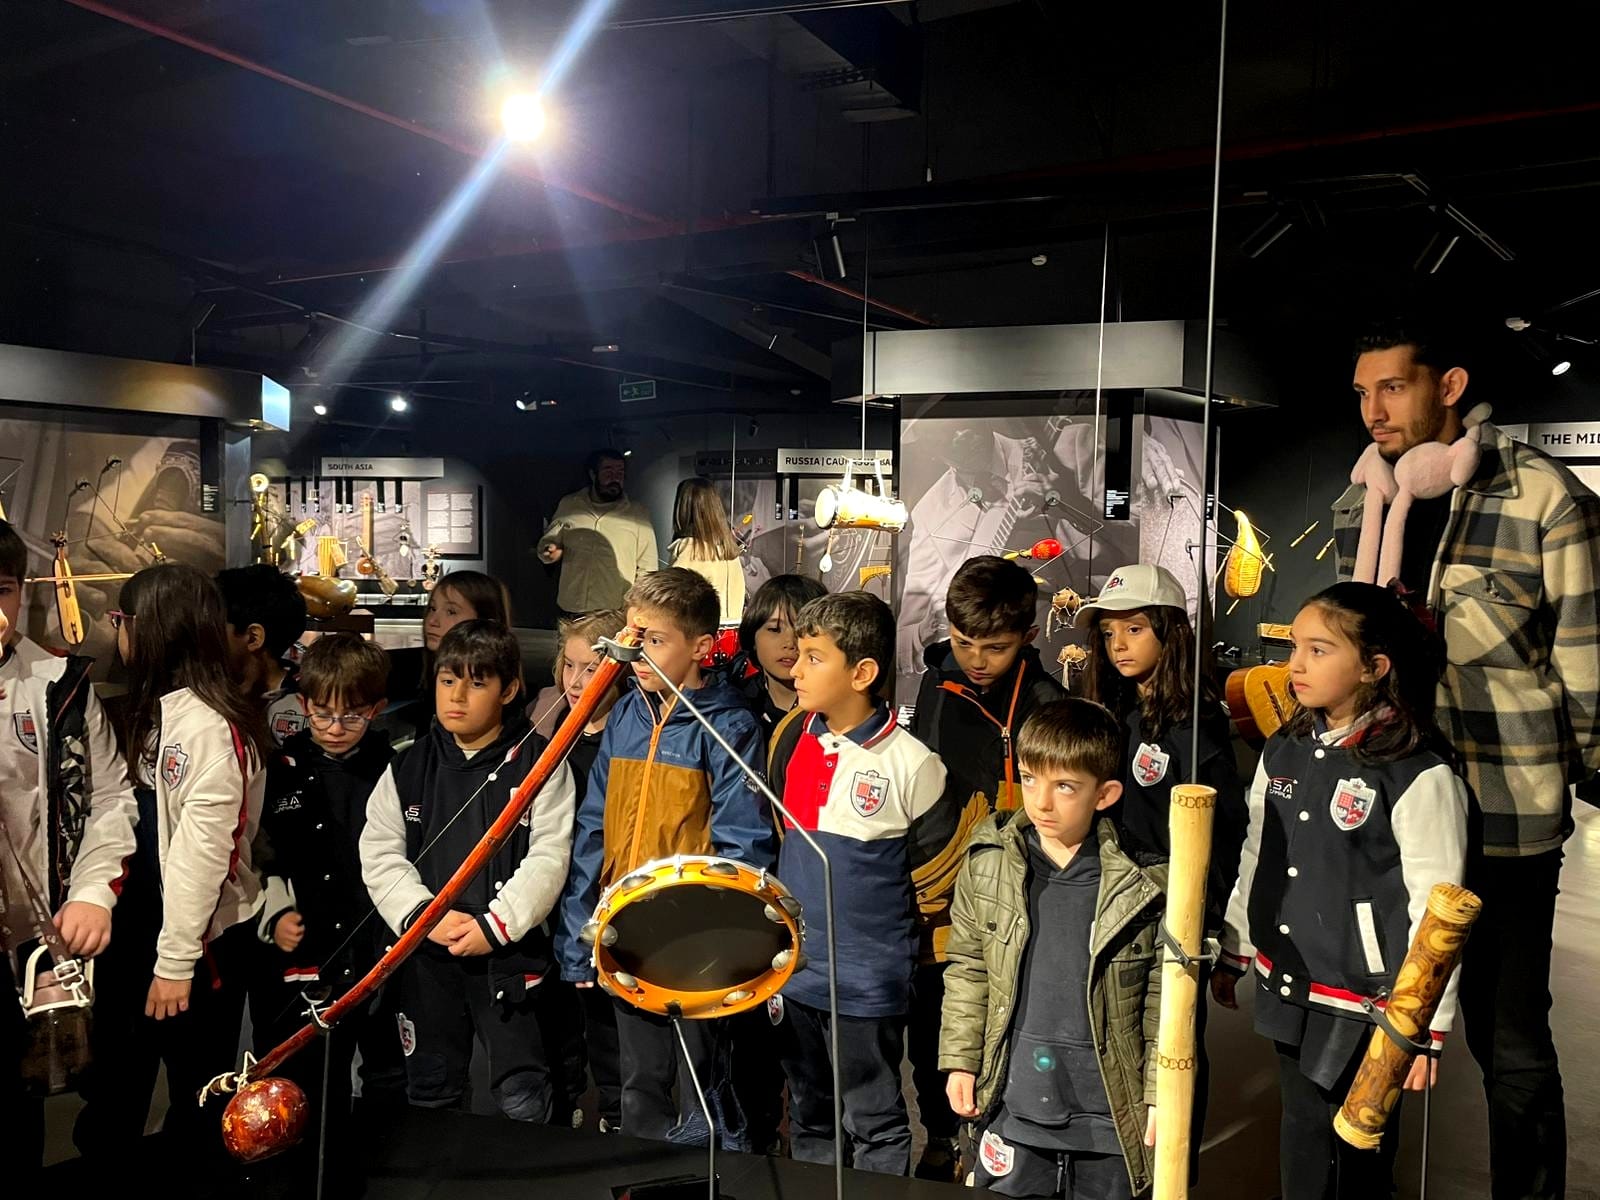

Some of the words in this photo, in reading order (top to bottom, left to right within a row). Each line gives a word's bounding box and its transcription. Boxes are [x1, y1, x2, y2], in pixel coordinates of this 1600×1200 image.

[1541, 433, 1572, 445] THE
[785, 456, 820, 466] RUSSIA
[327, 463, 354, 471] SOUTH
[355, 463, 374, 471] ASIA
